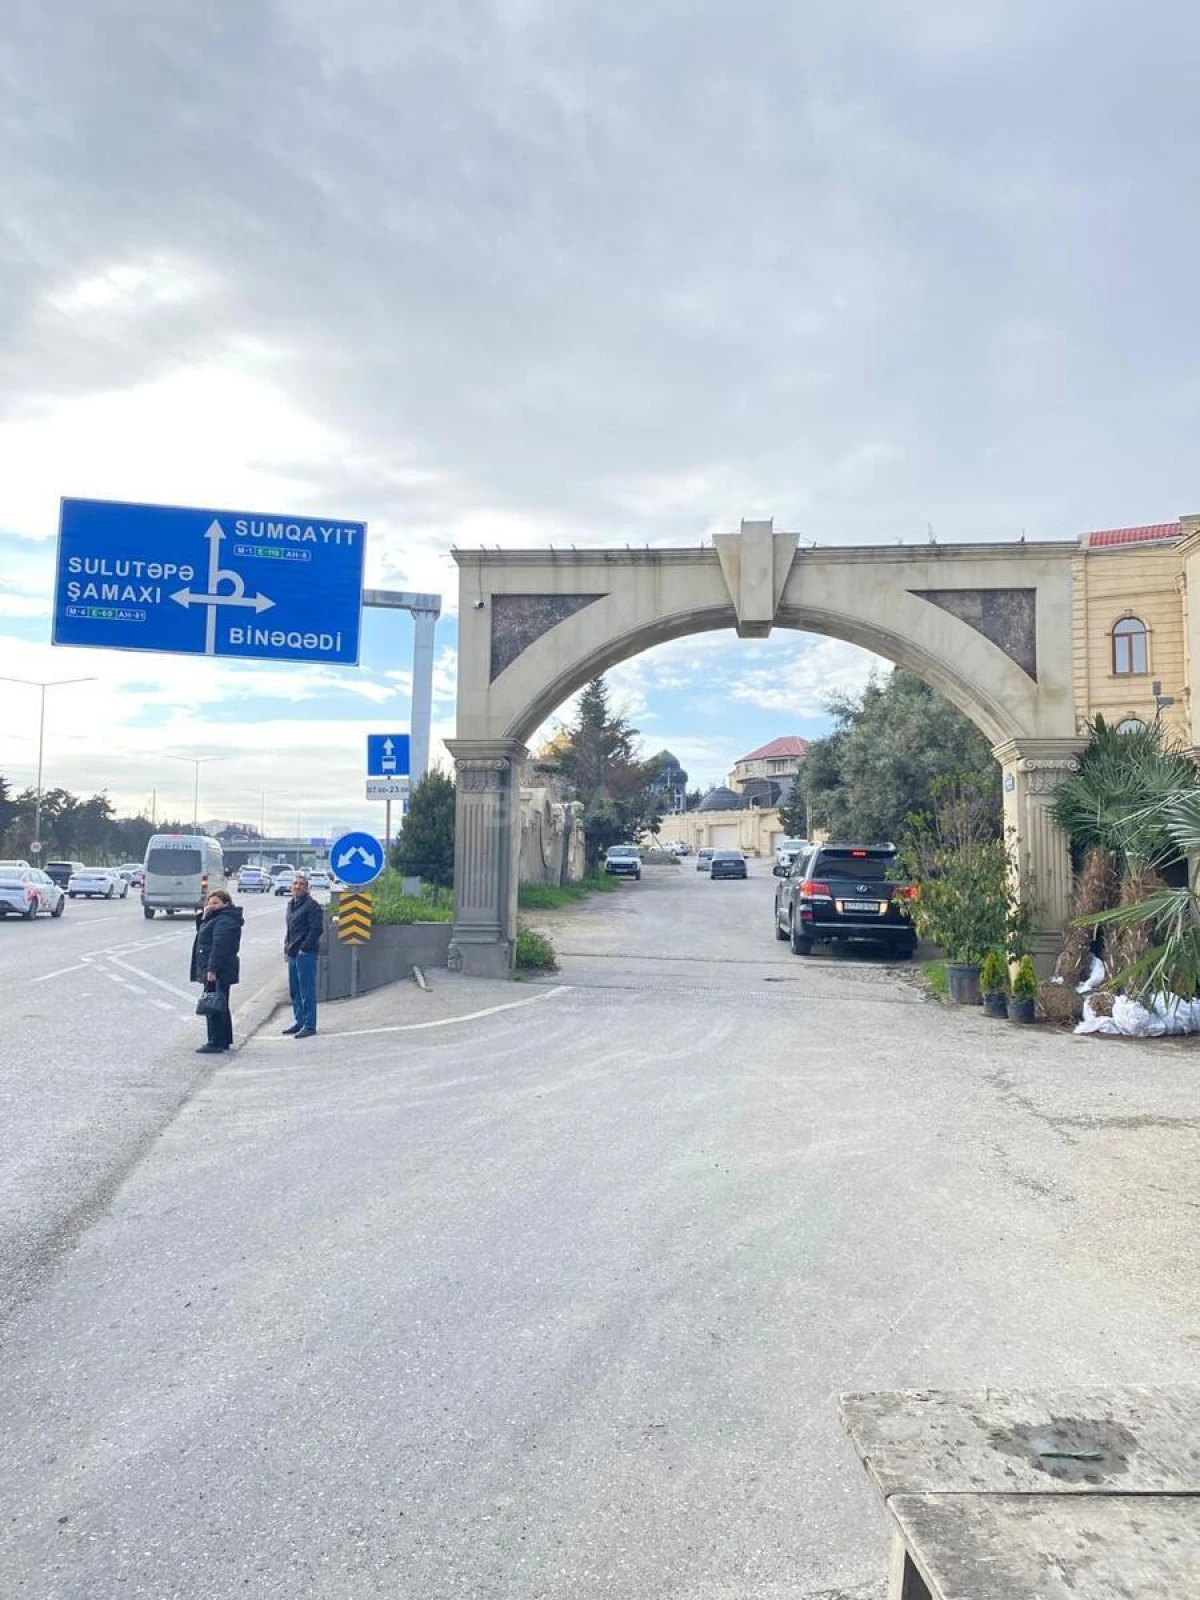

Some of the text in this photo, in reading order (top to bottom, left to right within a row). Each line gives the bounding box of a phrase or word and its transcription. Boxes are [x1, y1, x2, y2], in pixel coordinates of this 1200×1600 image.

[235, 519, 356, 545] SUMQAYIT
[68, 557, 194, 581] SULUTƏPƏ
[67, 581, 161, 604] ŞAMAXI
[229, 625, 342, 652] BİNƏQƏDİ
